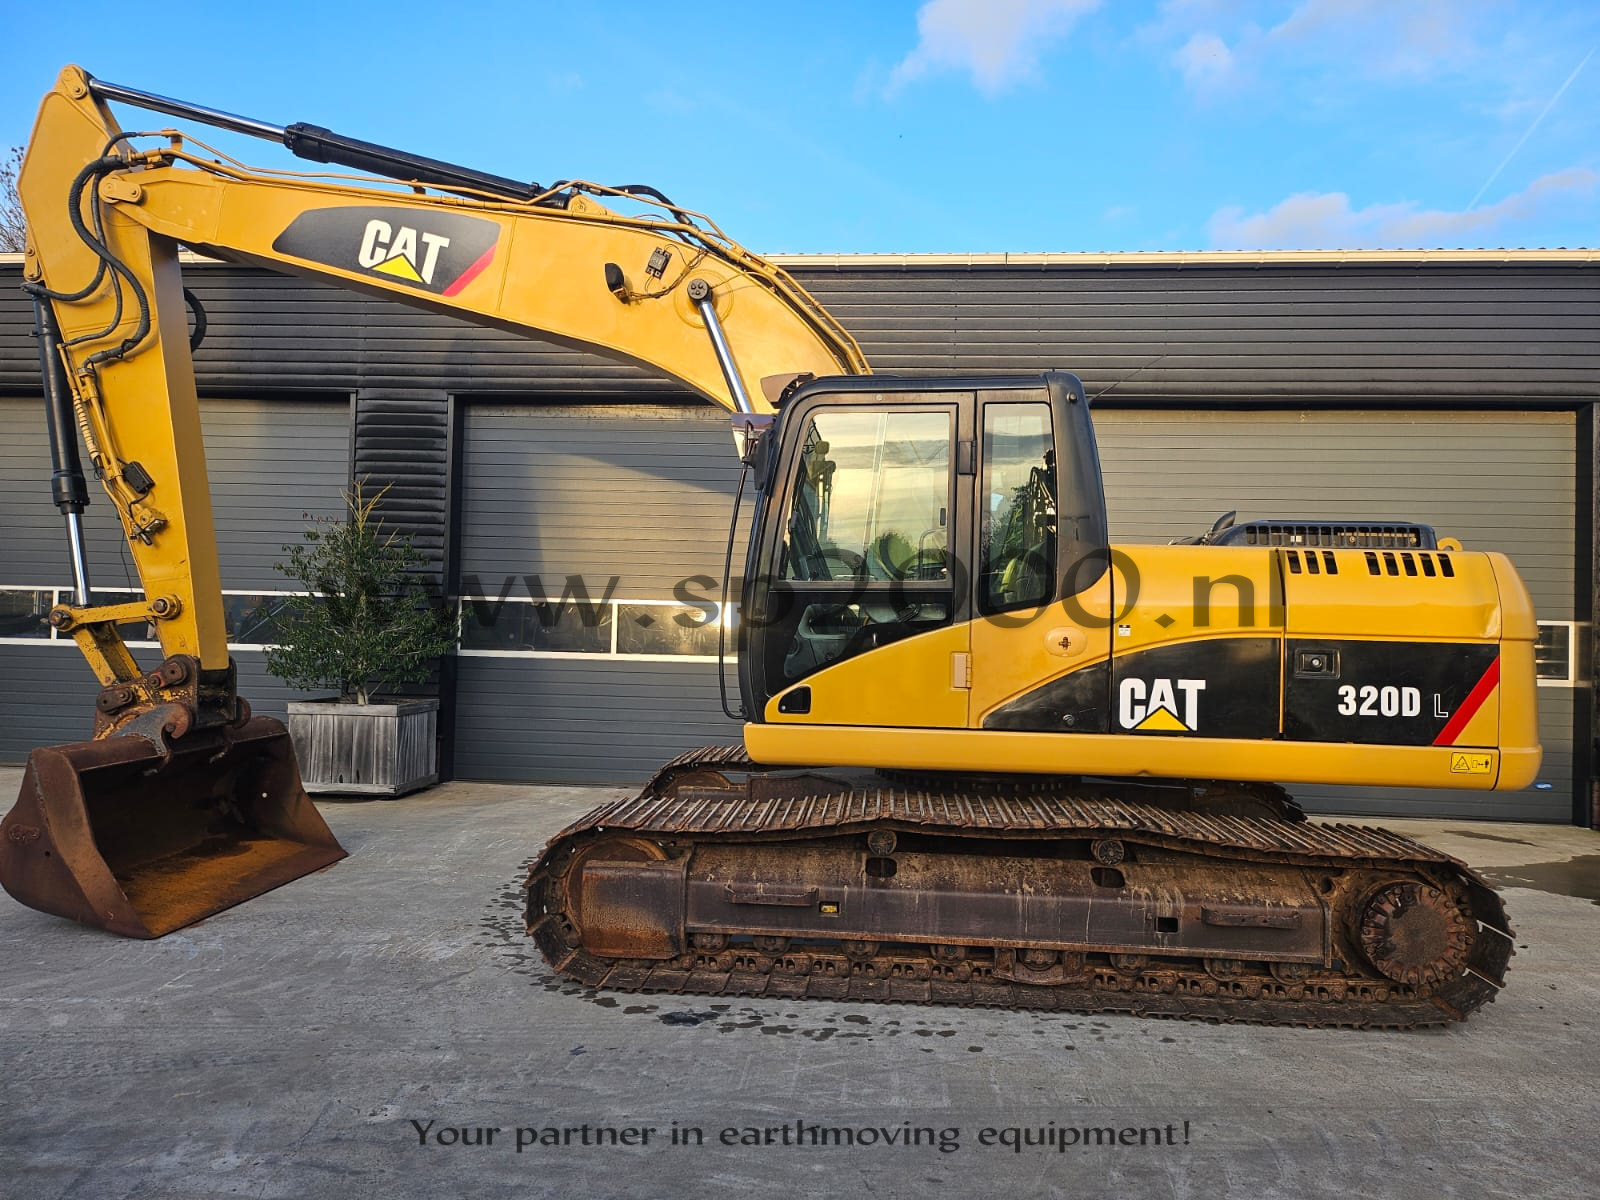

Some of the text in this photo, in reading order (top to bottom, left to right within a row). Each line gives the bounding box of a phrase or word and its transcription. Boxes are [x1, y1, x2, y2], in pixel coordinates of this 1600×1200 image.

[358, 219, 450, 285] CAT
[1119, 678, 1206, 731] CAT
[1337, 685, 1449, 718] 320D L
